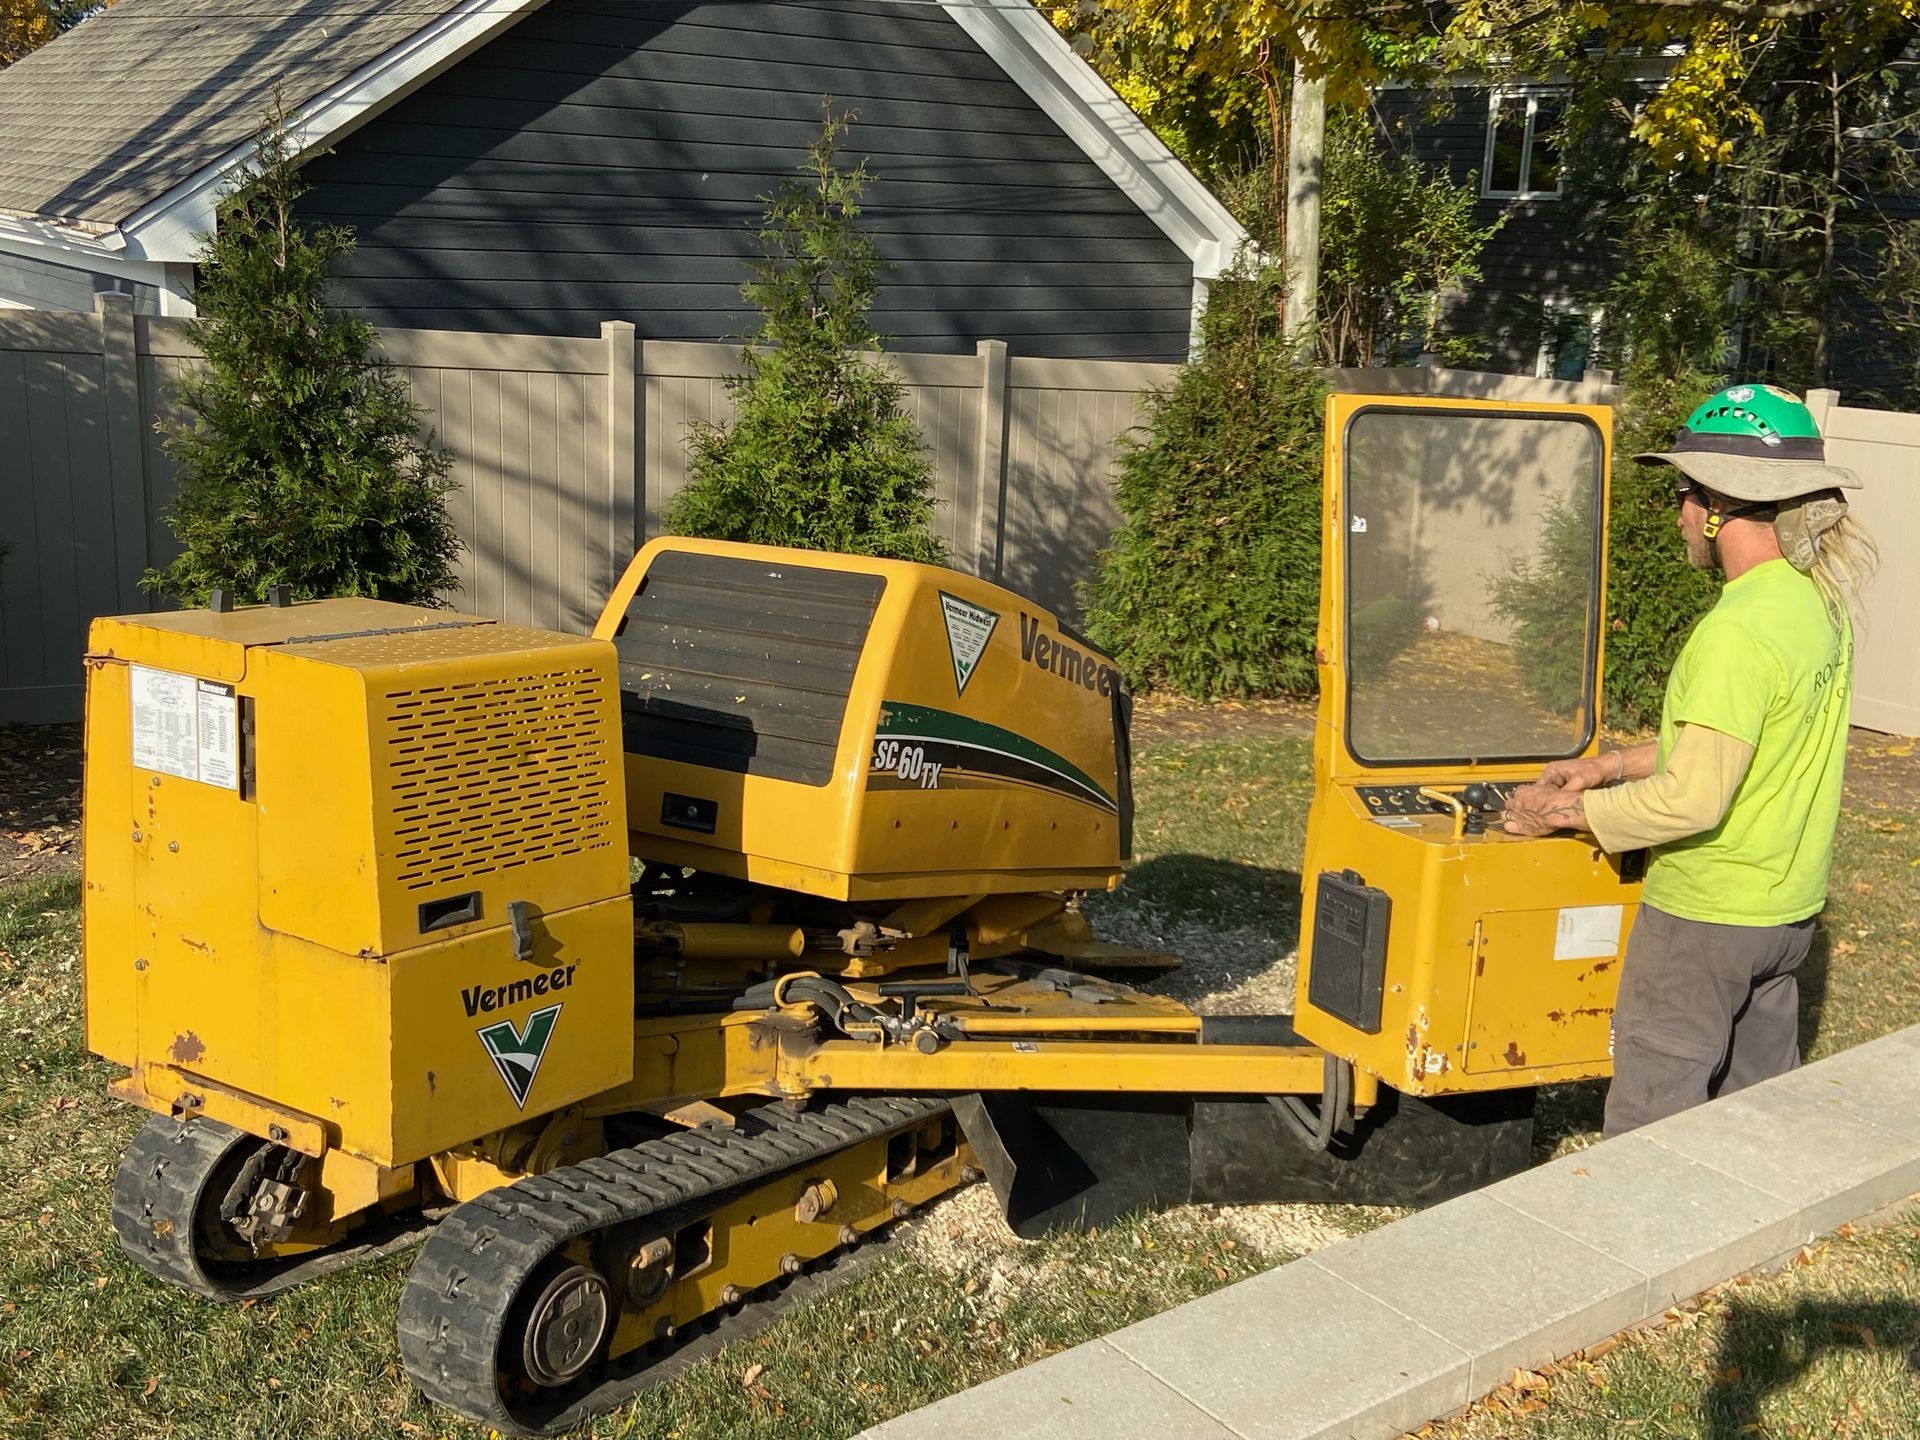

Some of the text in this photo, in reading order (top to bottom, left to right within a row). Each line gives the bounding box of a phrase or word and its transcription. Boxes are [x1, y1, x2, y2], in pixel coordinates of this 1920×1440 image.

[945, 601, 968, 617] Vermeer
[968, 610, 992, 628] Midwest
[1020, 611, 1118, 698] Vermee
[461, 964, 576, 1018] Vermeer
